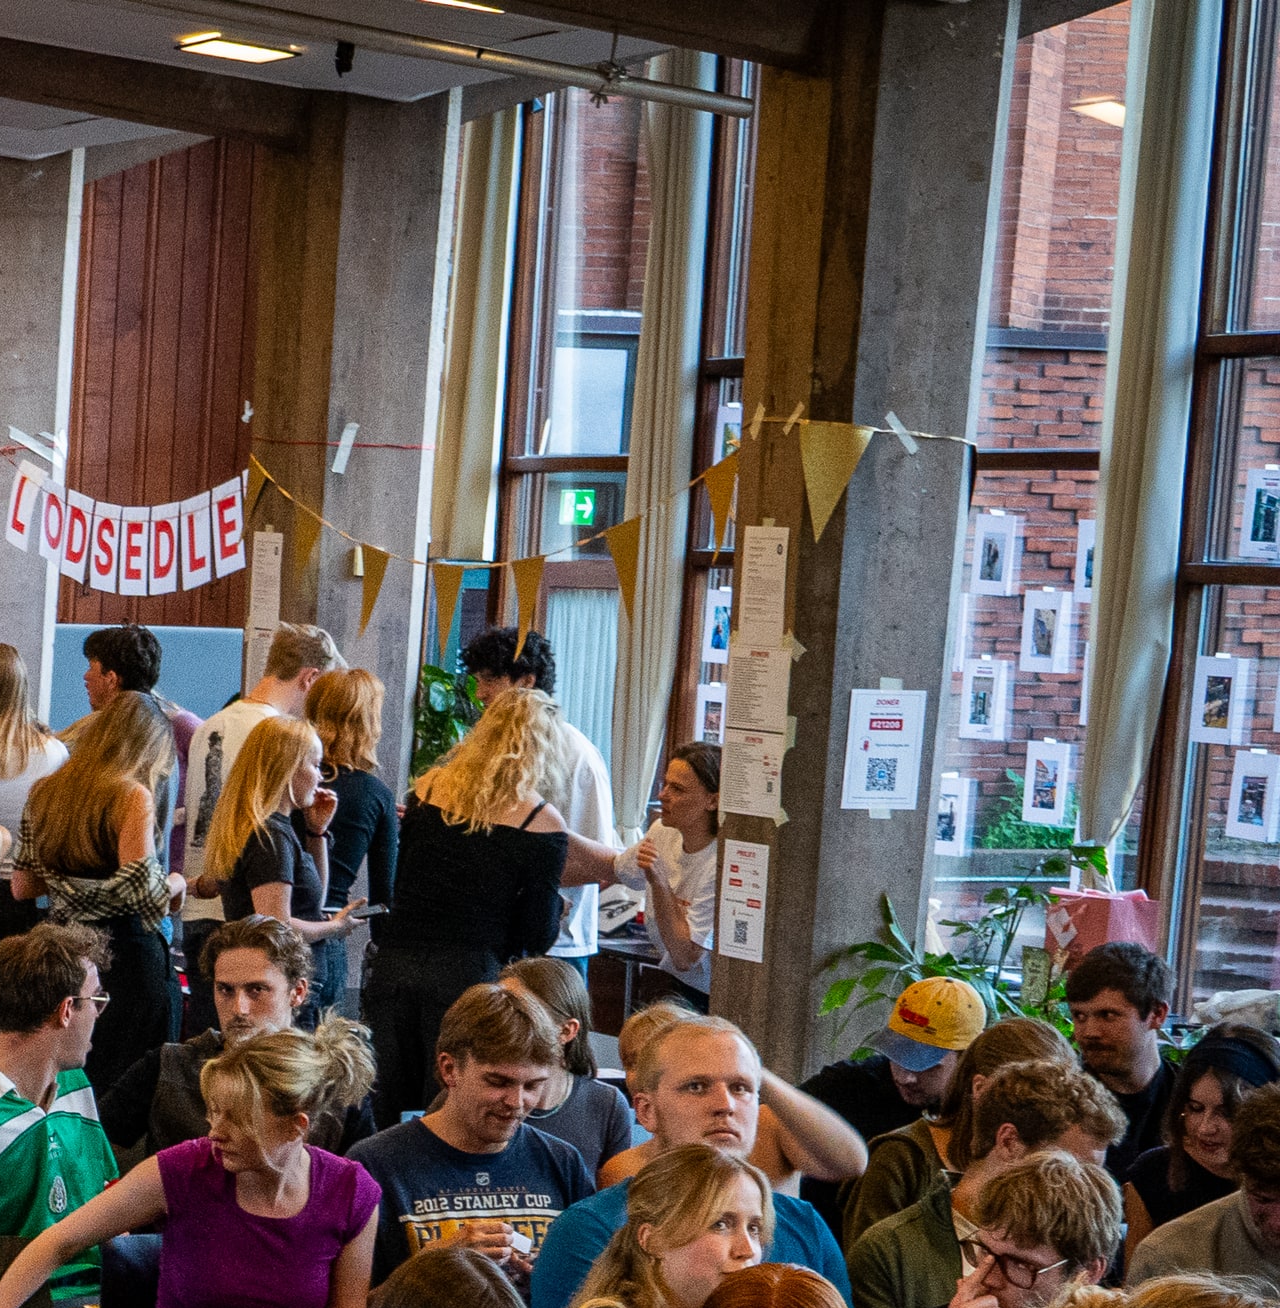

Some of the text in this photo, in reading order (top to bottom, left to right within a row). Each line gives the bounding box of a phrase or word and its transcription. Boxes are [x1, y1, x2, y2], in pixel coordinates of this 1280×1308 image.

[414, 1194, 552, 1214] 2012 STANLEY CUP
